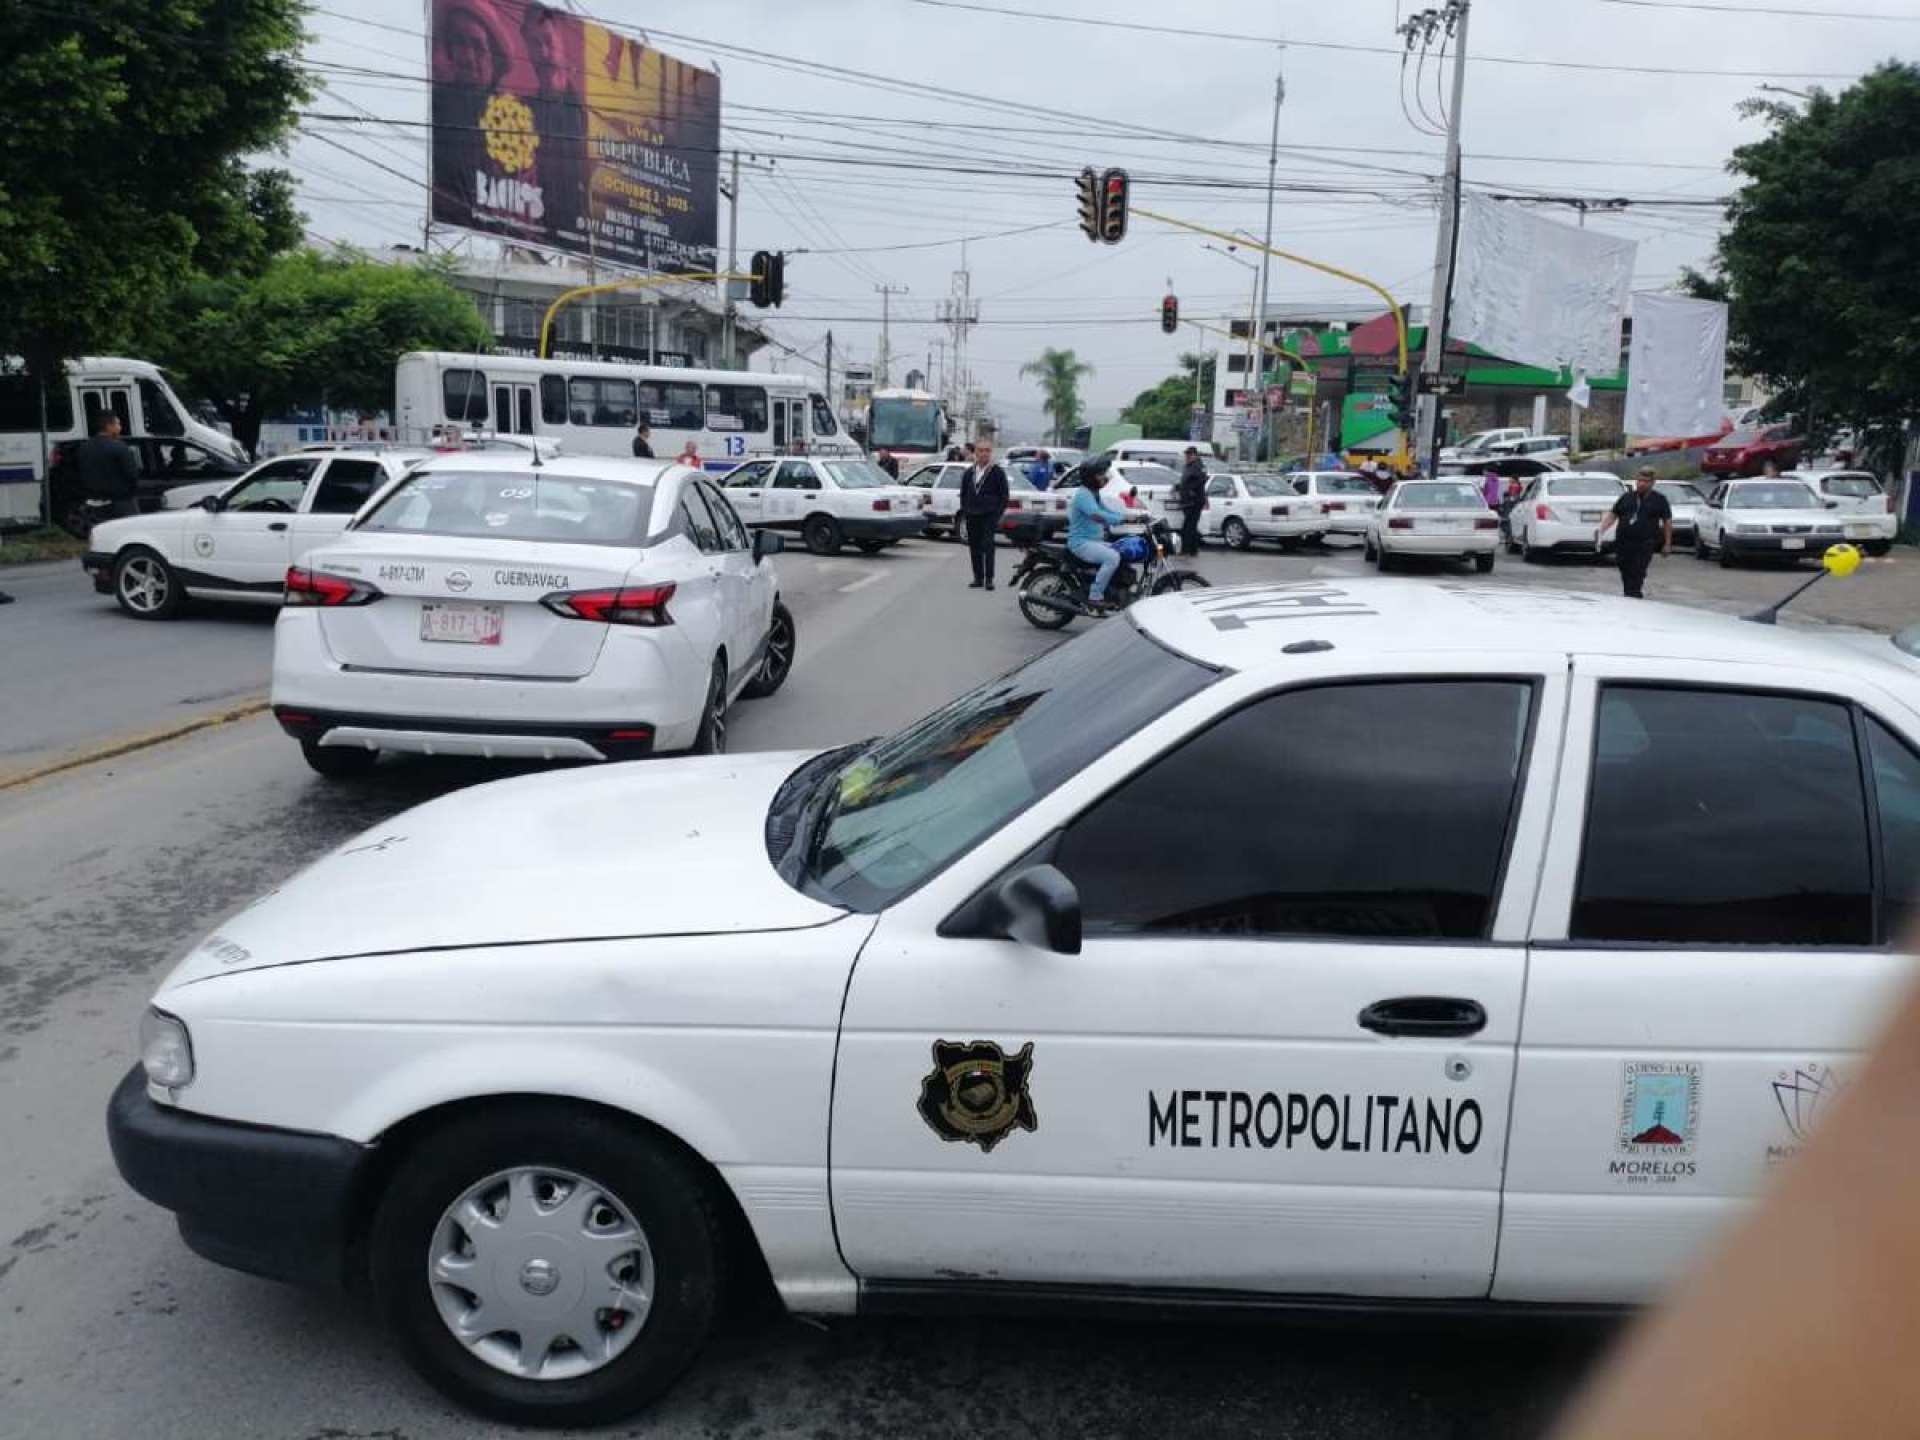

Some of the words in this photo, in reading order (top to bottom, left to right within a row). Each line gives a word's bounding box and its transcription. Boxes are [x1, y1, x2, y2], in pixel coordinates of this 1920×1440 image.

[724, 436, 745, 456] 13
[494, 570, 569, 590] CUERNAVACA
[1148, 1089, 1483, 1155] METROPOLITANO
[1609, 1161, 1698, 1176] MORELOS
